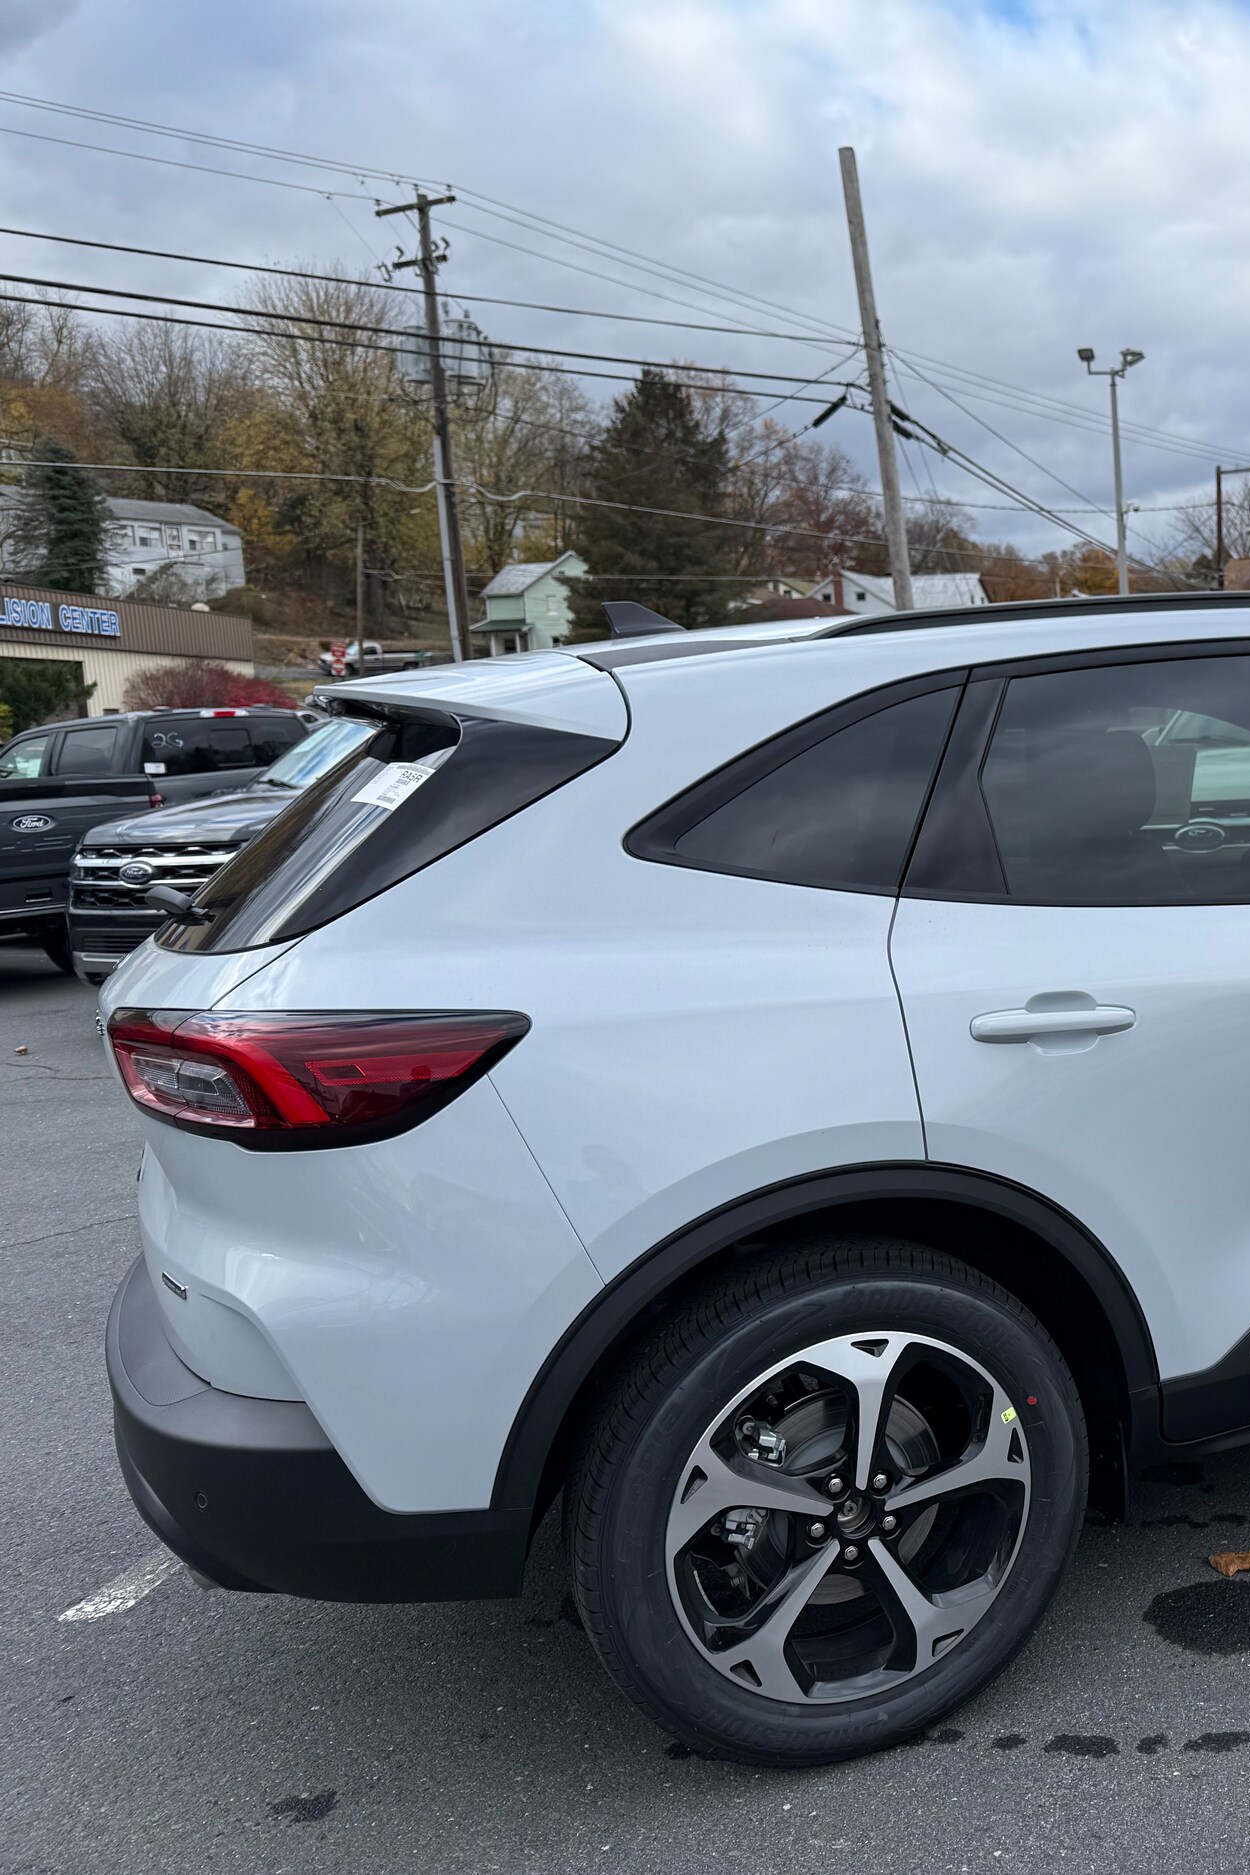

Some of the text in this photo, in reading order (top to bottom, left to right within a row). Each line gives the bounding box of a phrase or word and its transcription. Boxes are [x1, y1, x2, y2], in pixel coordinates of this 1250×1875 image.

[0, 597, 121, 636] ISION CENTER
[20, 817, 45, 829] Ford
